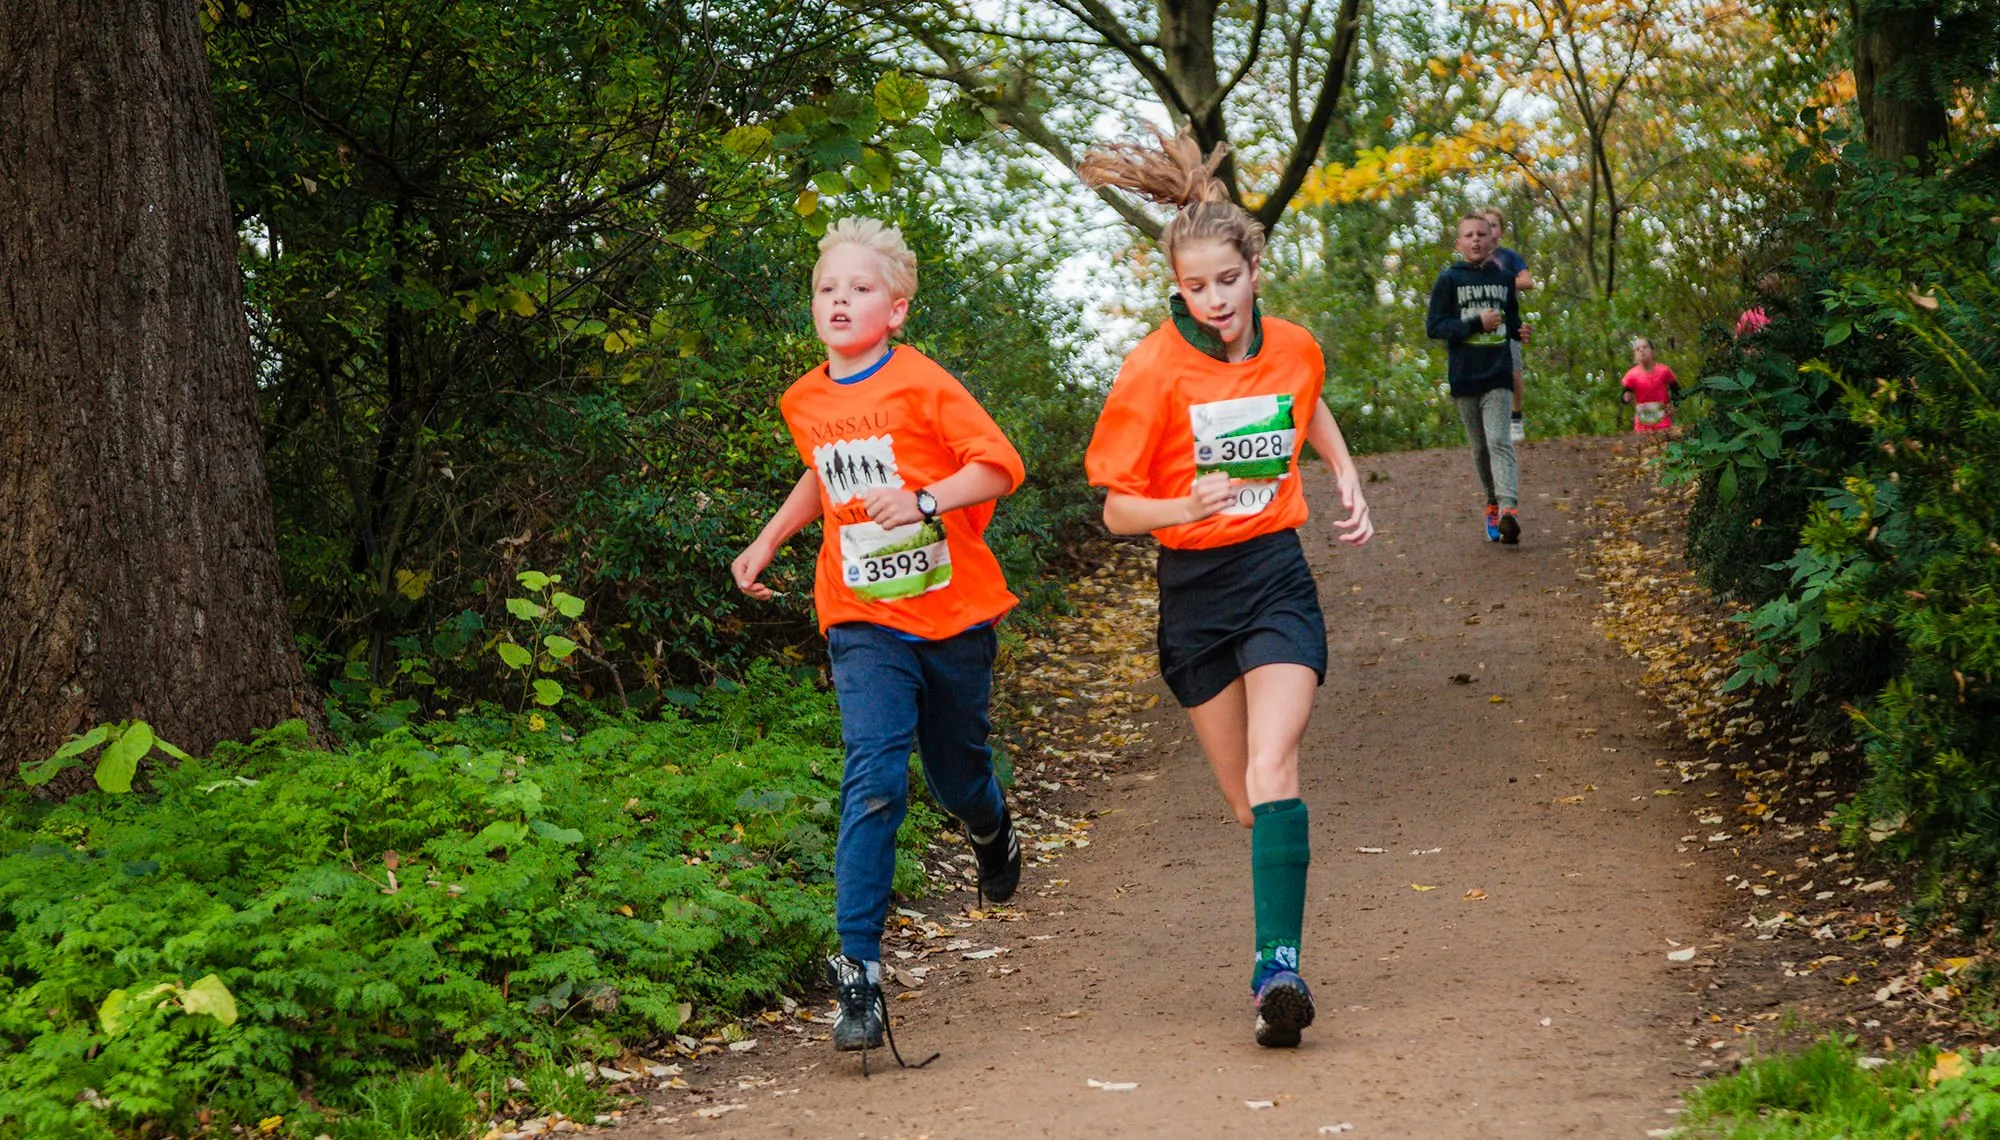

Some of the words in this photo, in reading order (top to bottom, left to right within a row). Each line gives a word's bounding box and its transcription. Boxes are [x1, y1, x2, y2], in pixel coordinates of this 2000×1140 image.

[1457, 284, 1483, 305] NEW
[810, 410, 889, 442] NASSAU
[1221, 434, 1282, 461] 3028
[864, 550, 929, 583] 3593
